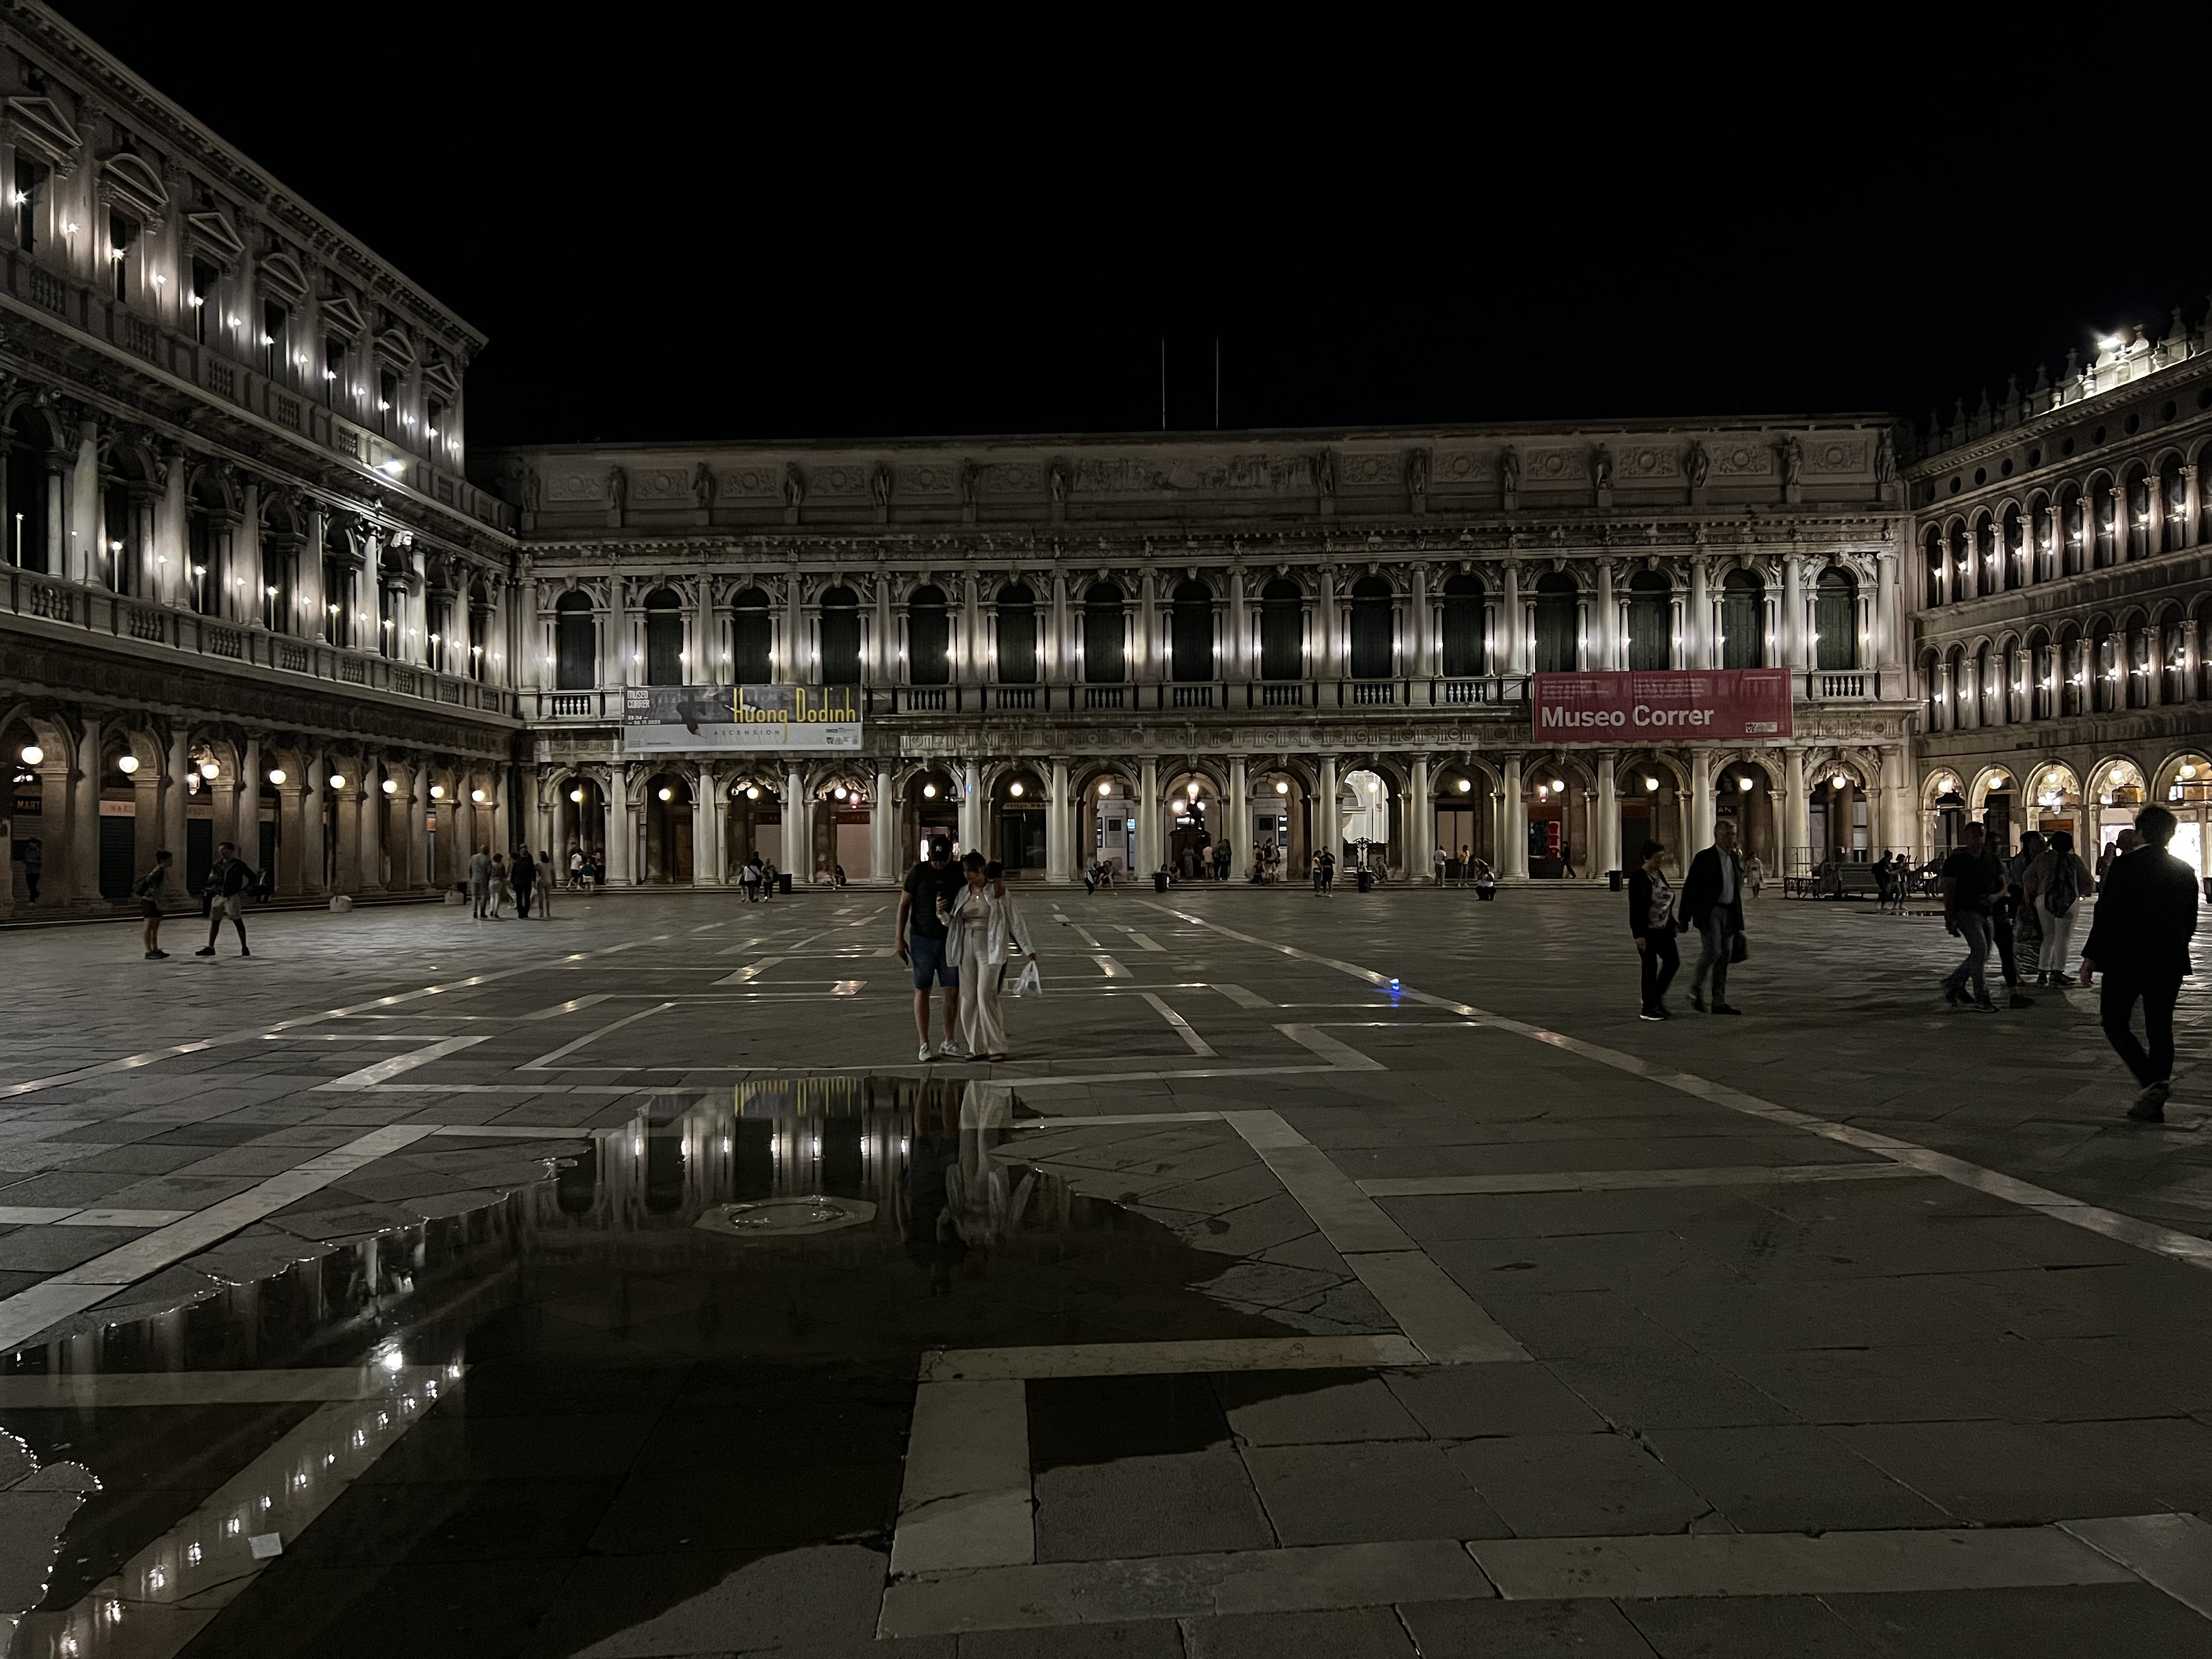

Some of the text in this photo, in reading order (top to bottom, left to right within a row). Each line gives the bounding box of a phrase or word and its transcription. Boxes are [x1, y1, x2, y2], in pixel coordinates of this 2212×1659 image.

[627, 690, 649, 699] MUSEO
[627, 700, 650, 708] CORRER
[733, 687, 855, 744] Huong Dodinh
[1541, 705, 1714, 727] Museo Correr
[17, 800, 40, 810] MART
